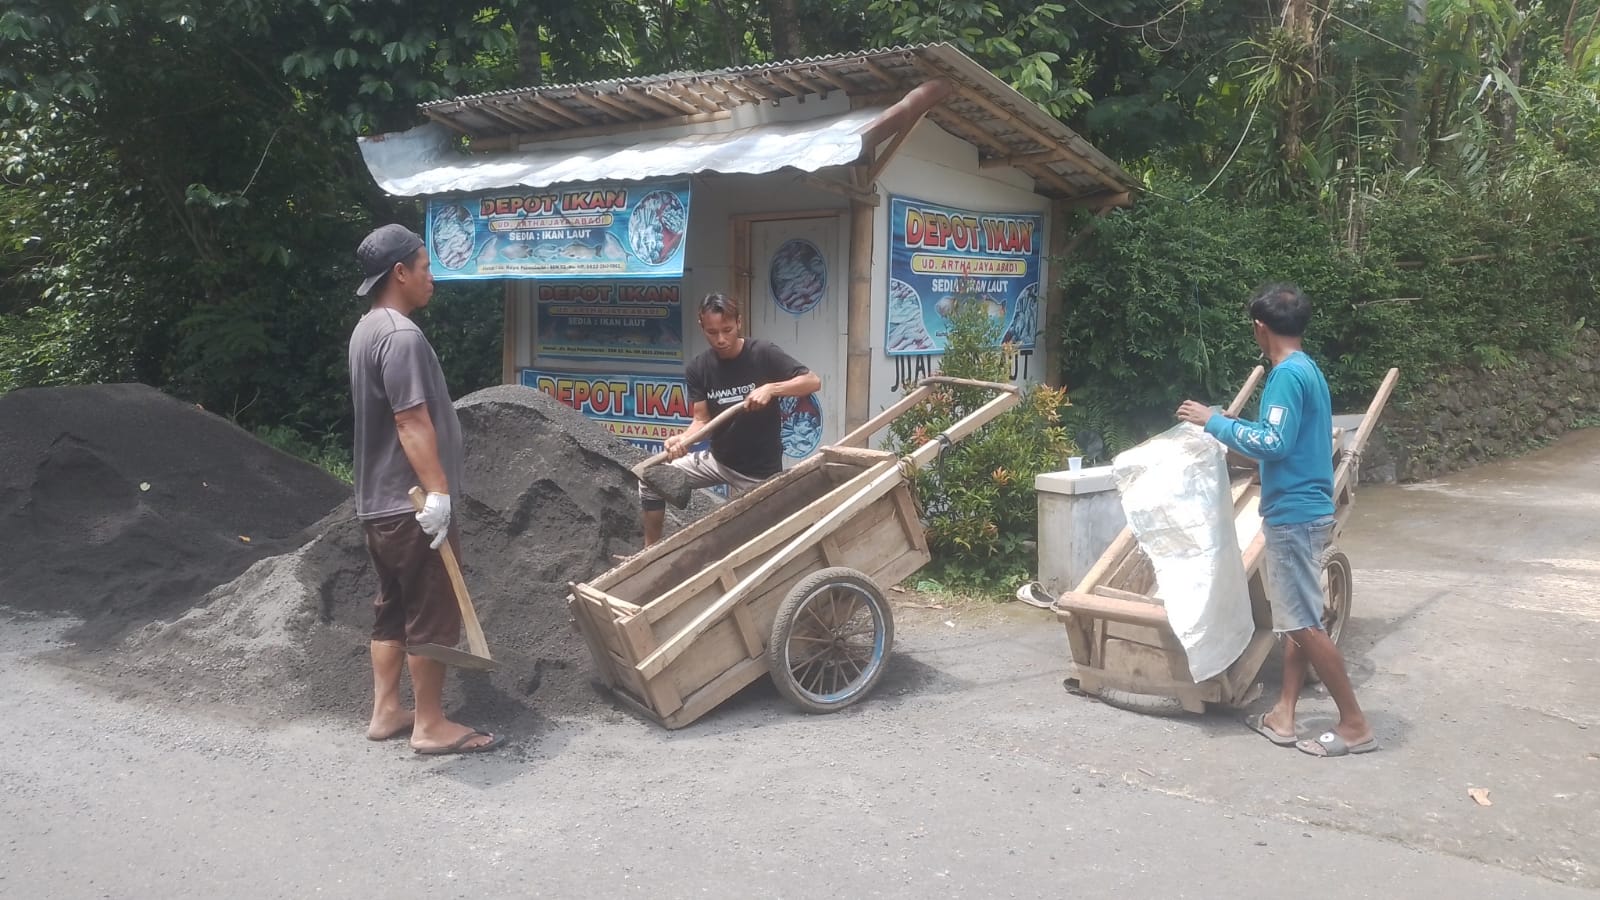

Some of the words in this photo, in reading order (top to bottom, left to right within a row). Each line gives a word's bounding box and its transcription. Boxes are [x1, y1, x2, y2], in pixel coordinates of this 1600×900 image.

[481, 194, 559, 216] DEPOT
[562, 190, 626, 211] IKAN
[509, 231, 534, 241] SEDIA
[542, 230, 564, 240] IKAN
[567, 229, 591, 239] LAUT
[906, 209, 979, 249] DEPOT
[984, 218, 1033, 252] IKAN
[941, 259, 971, 270] ARTHA
[974, 261, 994, 272] JAYA
[996, 262, 1018, 273] ABADI
[987, 280, 1009, 293] LAUT
[539, 285, 611, 302] DEPOT
[619, 285, 679, 303] IKAN
[599, 318, 620, 326] IKAN
[623, 318, 646, 327] LAUT
[620, 425, 648, 436] JAYA
[652, 428, 684, 439] ABAD
